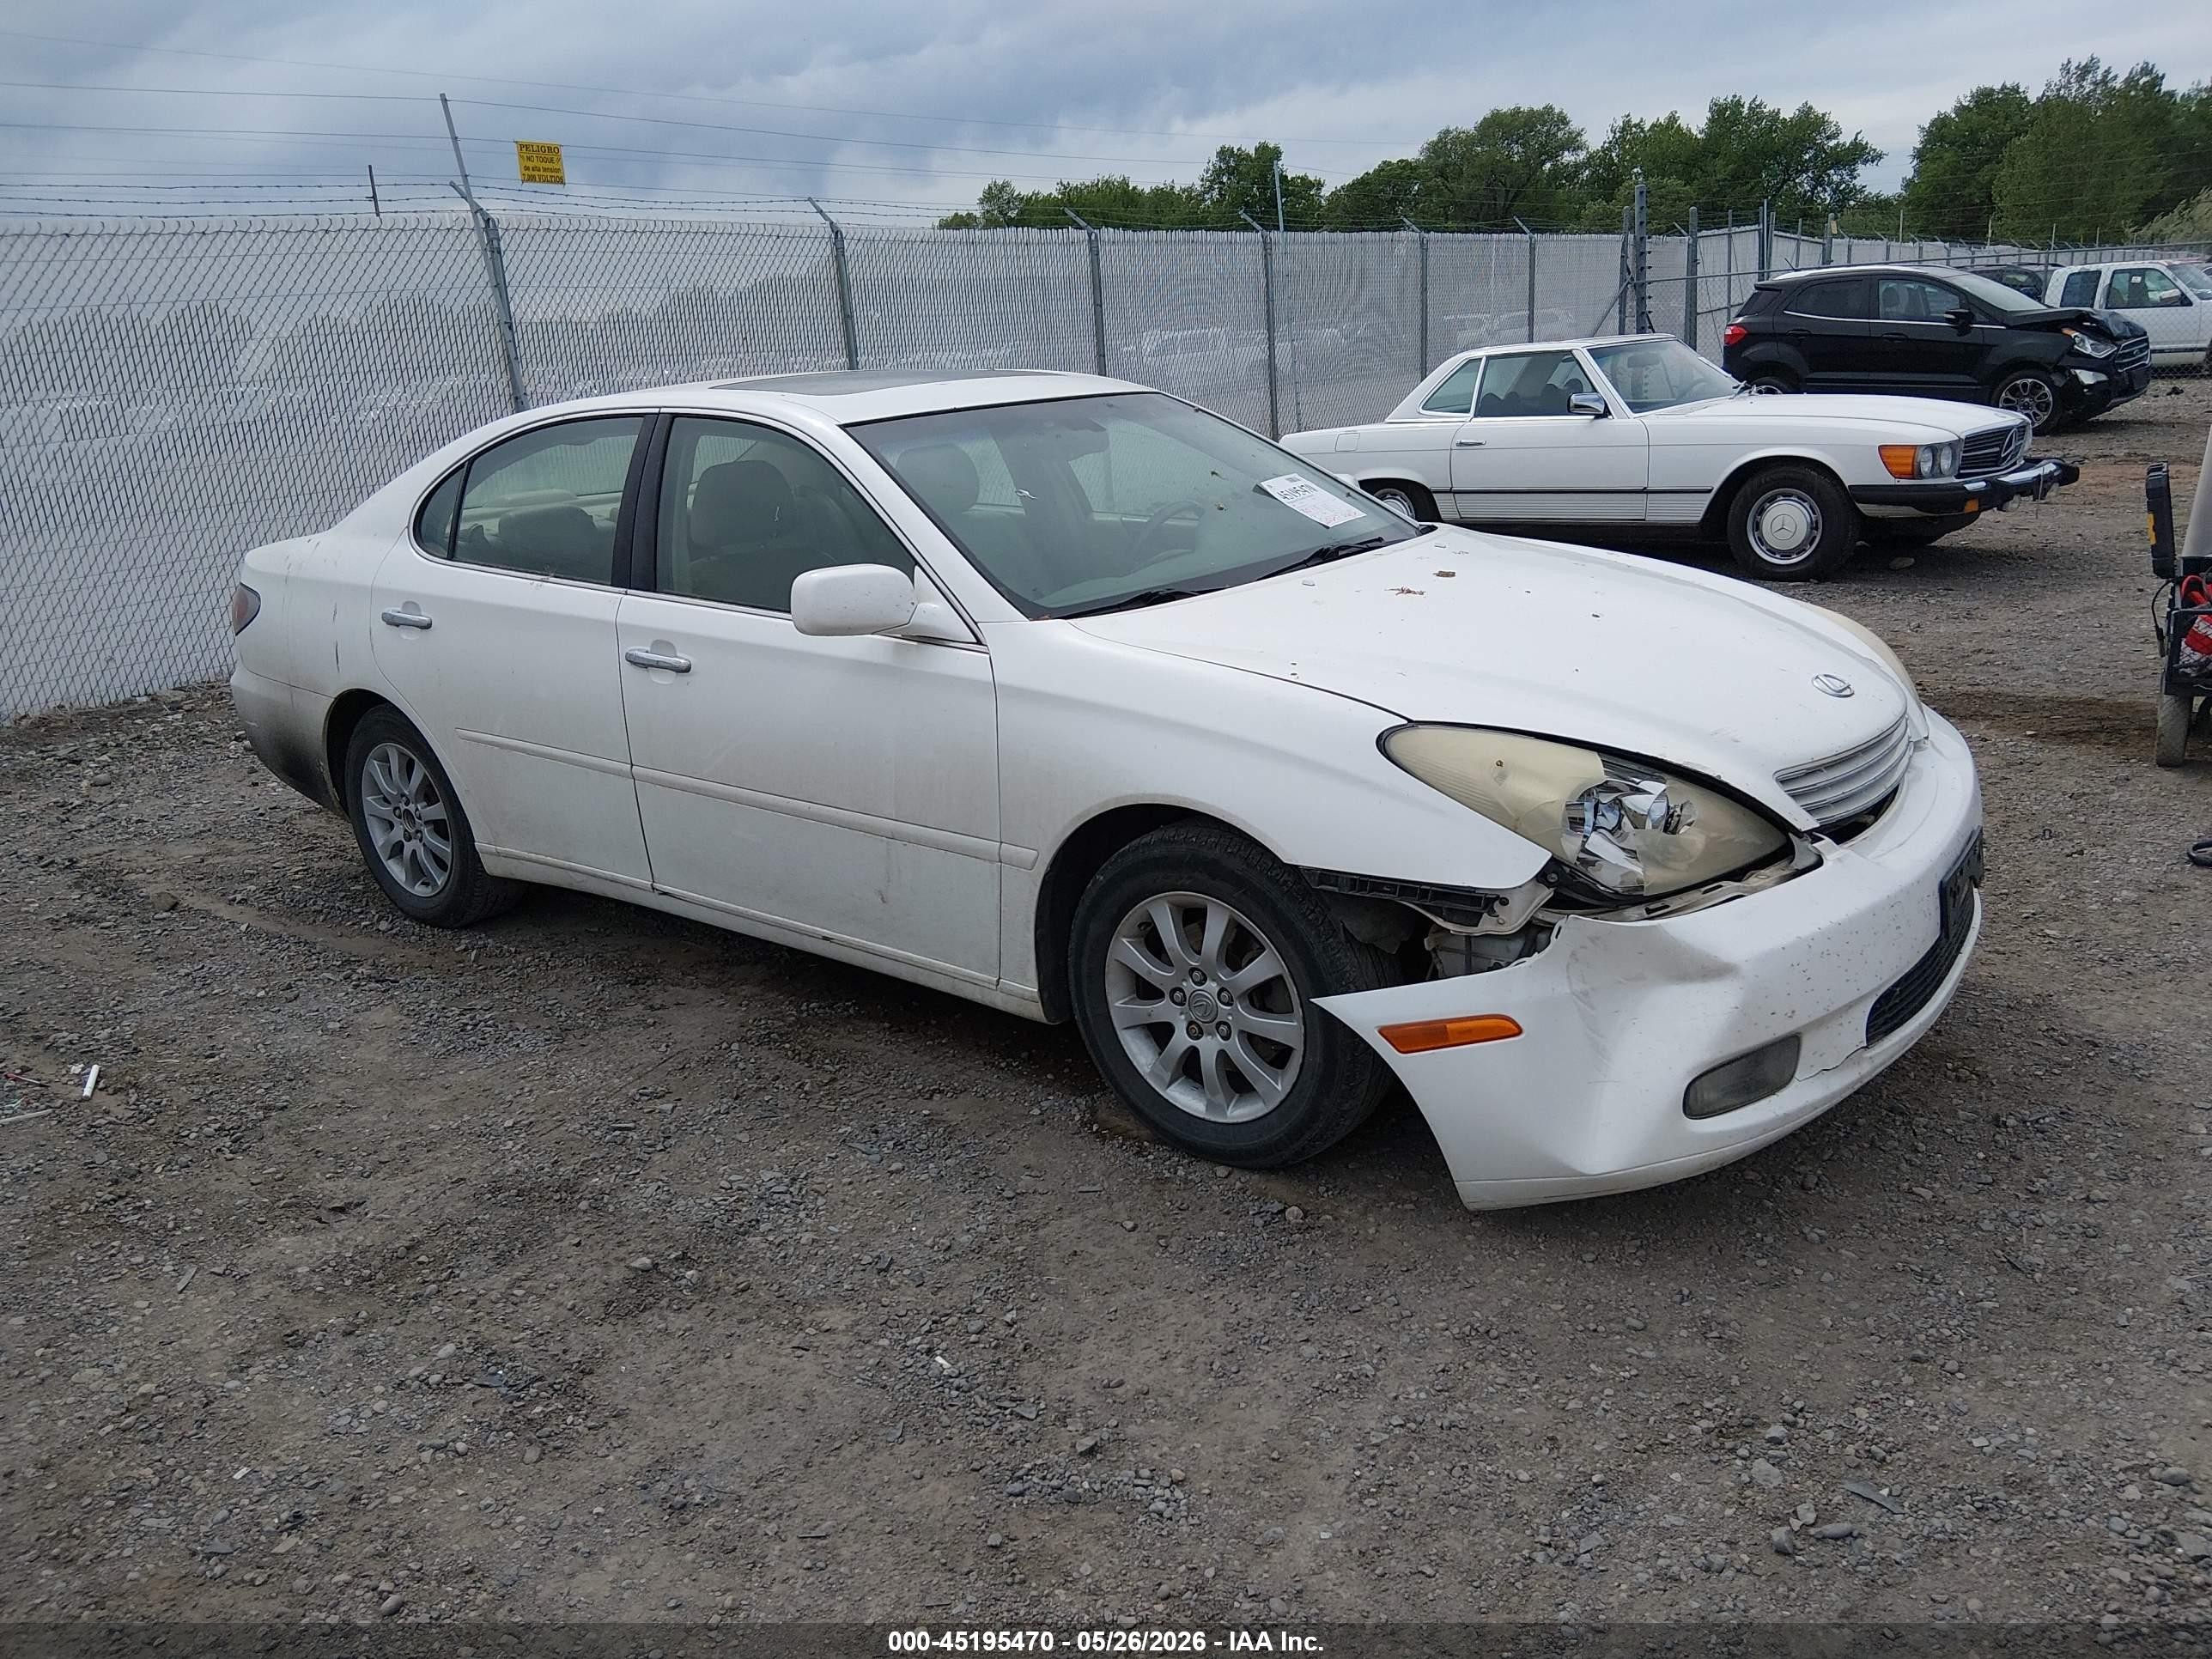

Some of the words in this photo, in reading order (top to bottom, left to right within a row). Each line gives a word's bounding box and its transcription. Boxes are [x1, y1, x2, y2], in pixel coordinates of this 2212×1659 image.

[520, 144, 560, 155] PELIGRO
[536, 155, 556, 164] TOQUE
[538, 174, 563, 184] VOLTIOS
